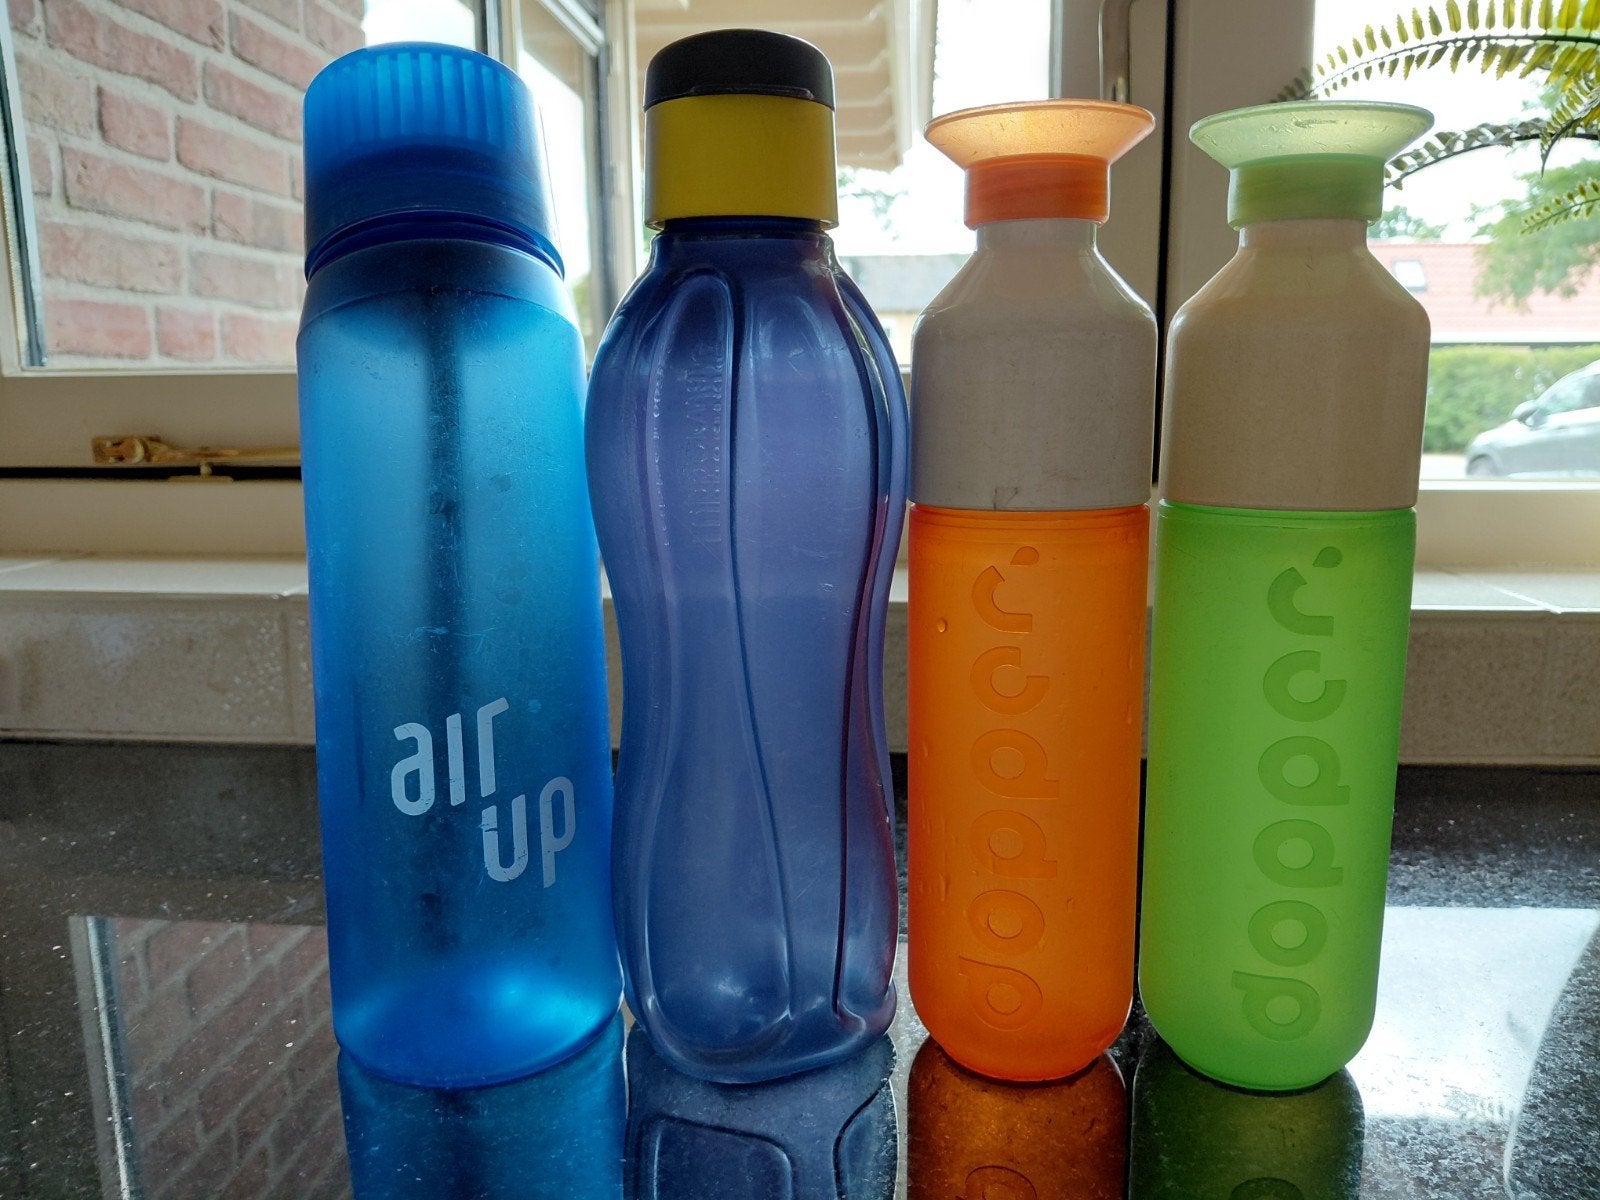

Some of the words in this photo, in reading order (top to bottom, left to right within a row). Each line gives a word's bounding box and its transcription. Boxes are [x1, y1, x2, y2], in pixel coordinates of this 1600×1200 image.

[391, 697, 510, 816] air
[481, 776, 577, 889] up
[958, 545, 1060, 1031] dopper
[1231, 546, 1351, 1042] dopper
